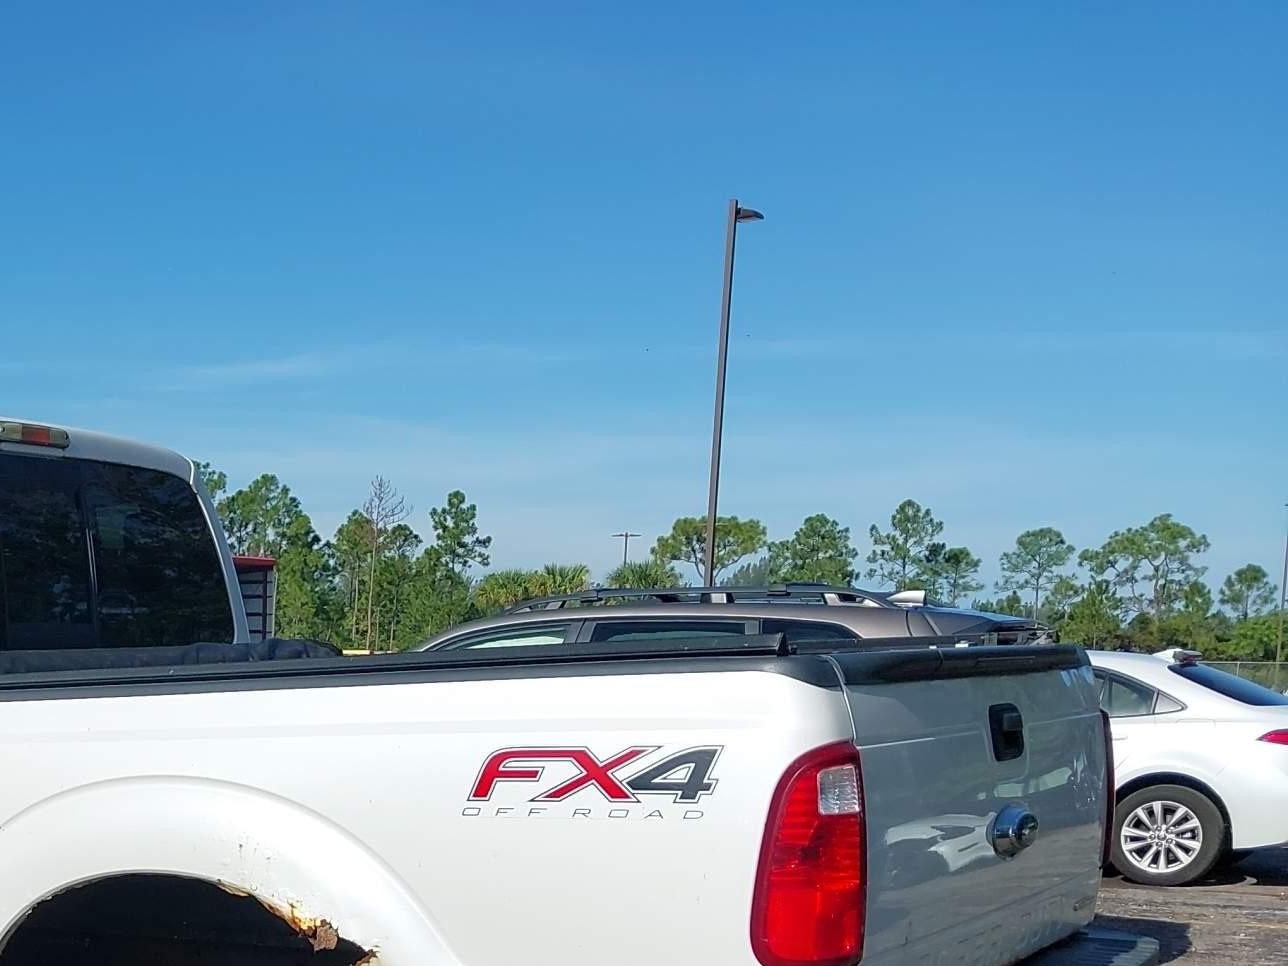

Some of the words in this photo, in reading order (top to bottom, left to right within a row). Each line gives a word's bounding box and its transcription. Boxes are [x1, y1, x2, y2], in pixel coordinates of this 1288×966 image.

[466, 745, 725, 804] FX4
[461, 807, 549, 818] OFF
[571, 808, 705, 820] ROAD
